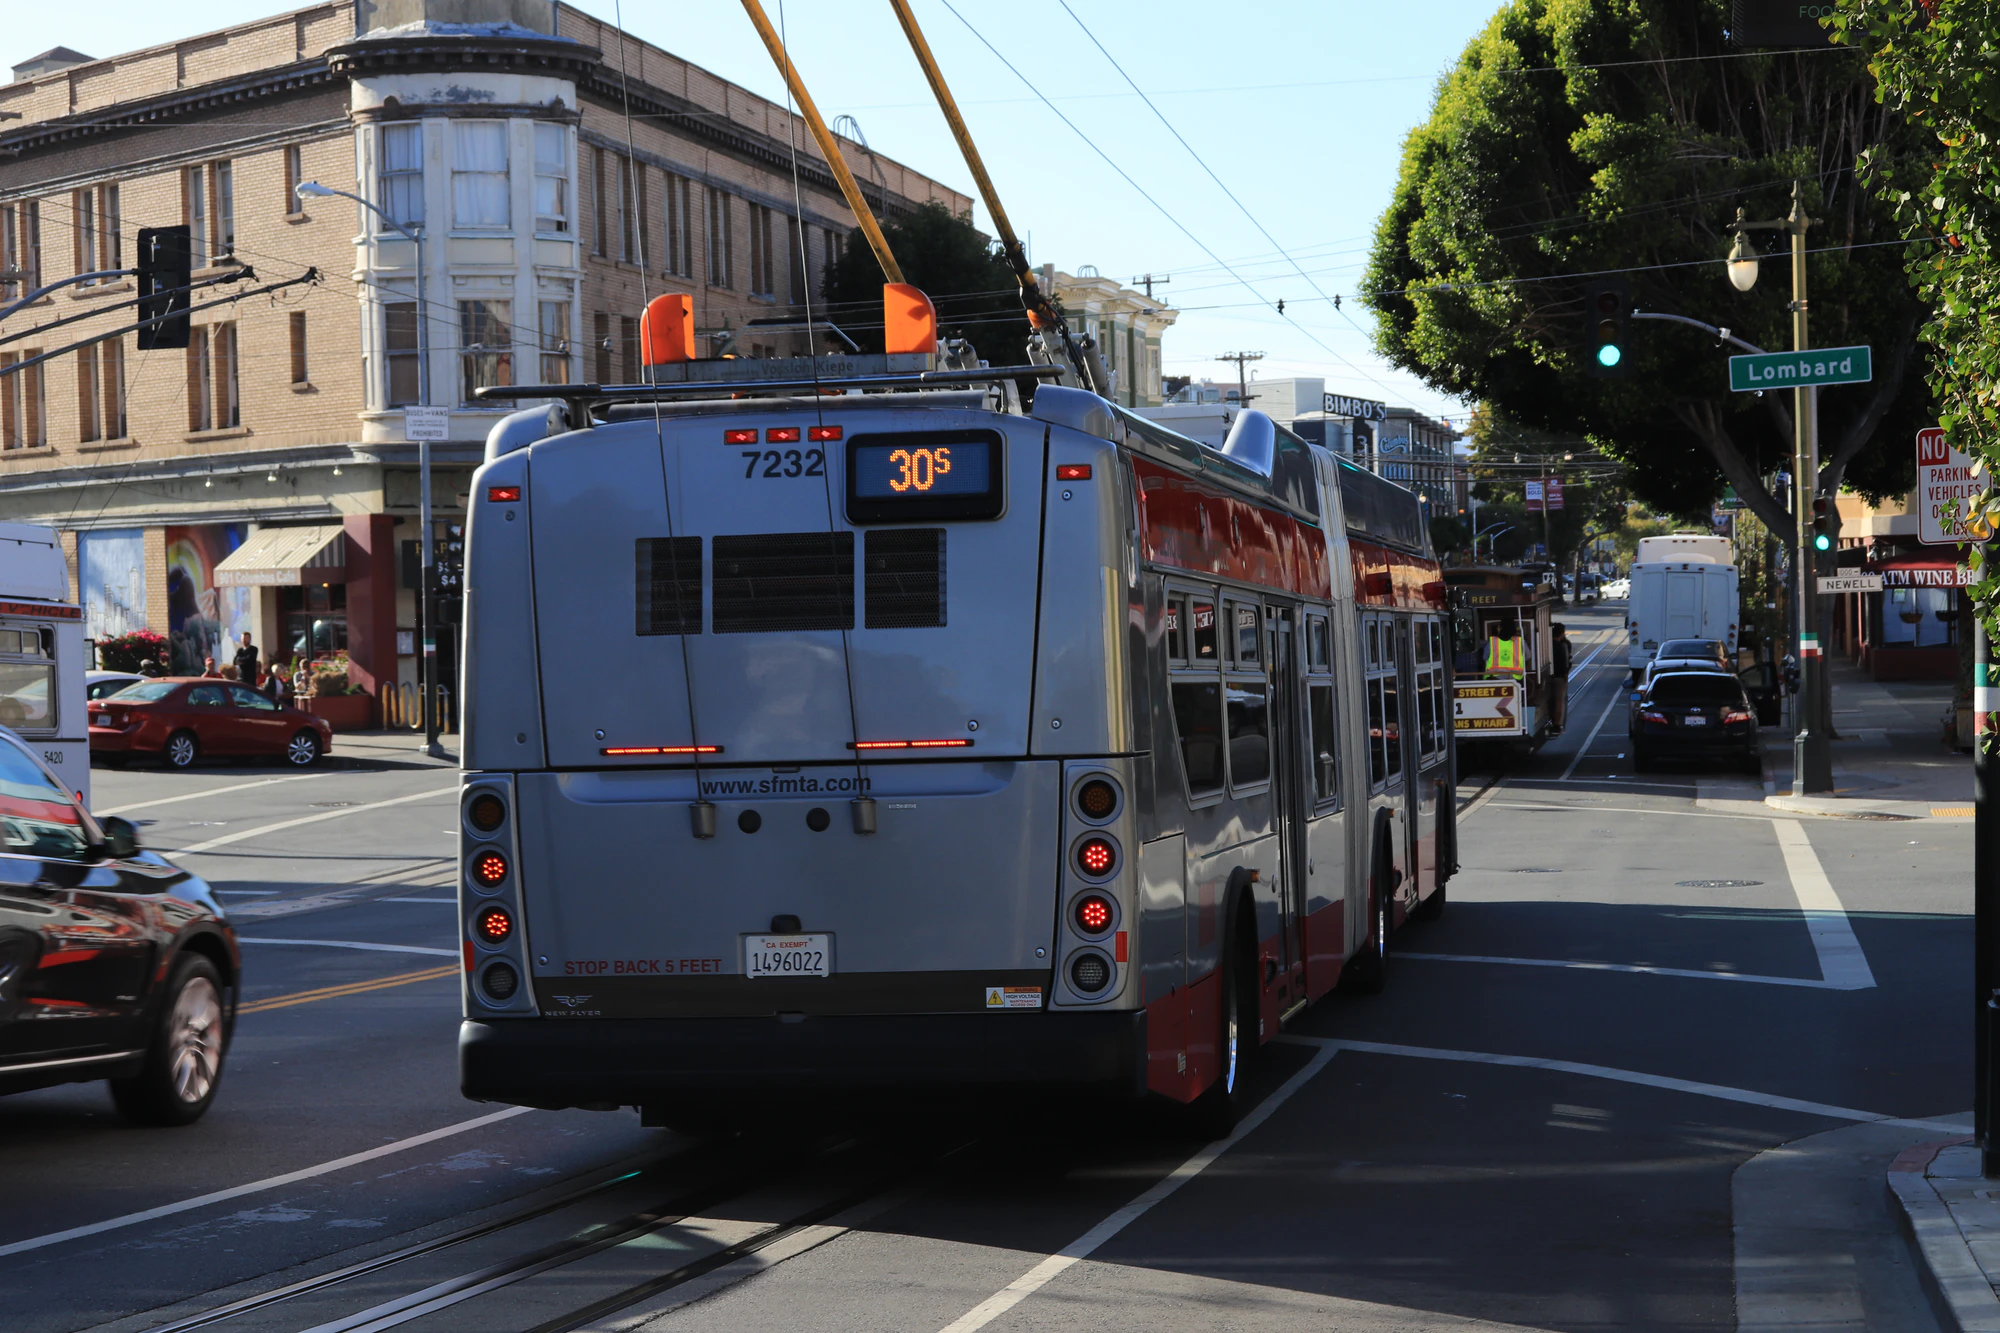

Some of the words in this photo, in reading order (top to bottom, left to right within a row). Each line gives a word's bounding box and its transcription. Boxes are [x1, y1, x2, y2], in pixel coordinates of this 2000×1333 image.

[1800, 5, 1844, 18] FOO
[761, 361, 810, 376] Vossloh
[817, 359, 853, 376] Kiepe
[1749, 357, 1851, 381] Lombard
[431, 409, 448, 417] VANS
[1325, 394, 1386, 421] BIMBO'S
[412, 429, 443, 437] PROHIBITED
[1380, 434, 1408, 454] Columbus
[1921, 434, 1945, 461] NO
[741, 448, 824, 479] 7232
[1931, 466, 1978, 482] PARKIN
[1928, 484, 1983, 501] VEHICLES
[219, 572, 233, 584] 901
[235, 571, 275, 584] Columbus
[441, 575, 457, 587] $4
[1826, 579, 1875, 590] NEWELL
[1881, 570, 1911, 586] ATM
[1913, 570, 1954, 586] WINE
[1956, 570, 1974, 586] BE
[1471, 595, 1497, 604] REET
[1458, 688, 1496, 697] STREET
[1473, 718, 1509, 728] WHARF
[44, 751, 64, 764] 5420
[701, 775, 872, 795] www.sfmta.com
[780, 941, 808, 949] EXEMPT
[565, 960, 609, 975] STOP
[613, 959, 660, 974] BACK
[665, 959, 675, 973] 5
[679, 958, 723, 973] FEET
[752, 951, 823, 972] 1496022
